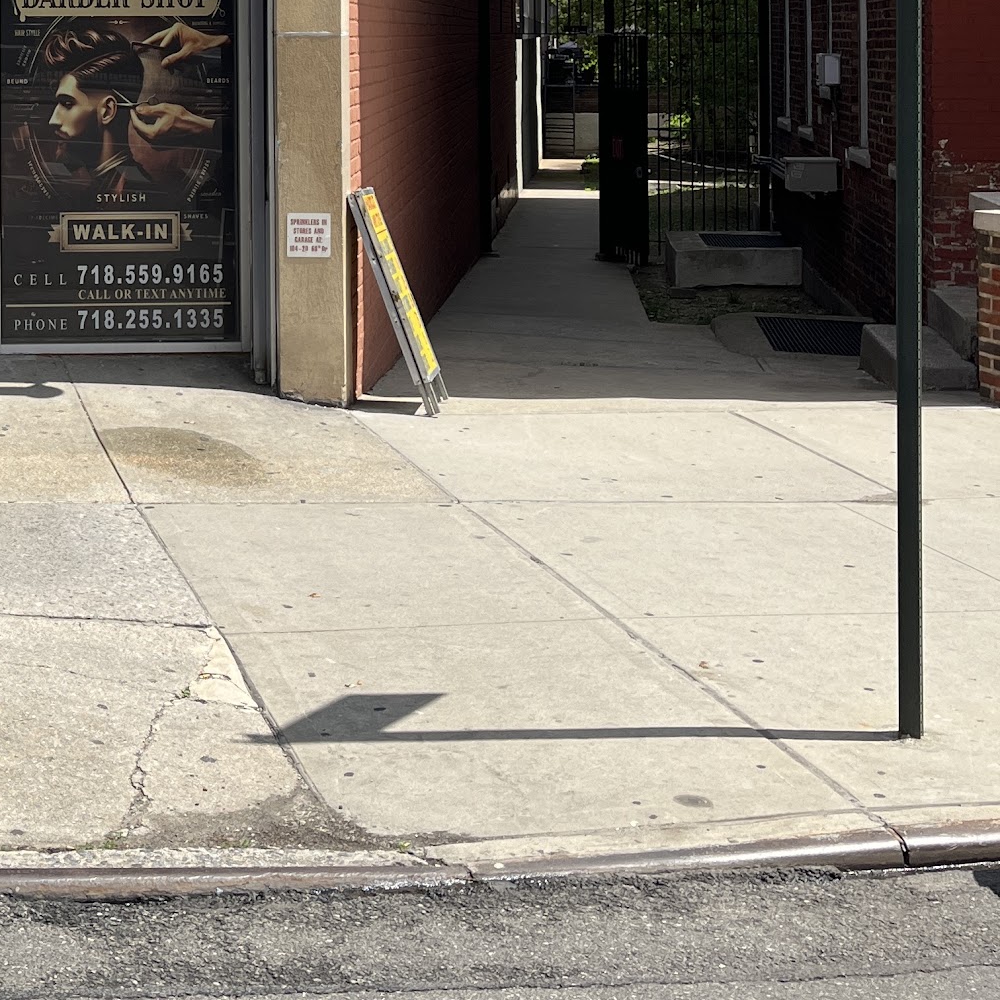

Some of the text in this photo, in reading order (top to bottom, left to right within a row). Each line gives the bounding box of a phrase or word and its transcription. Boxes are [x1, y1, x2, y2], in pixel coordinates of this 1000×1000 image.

[96, 193, 147, 203] STYLISH
[73, 223, 169, 240] WALK-IN
[313, 227, 325, 235] AND
[14, 263, 224, 286] CELL 718.559.9165
[78, 288, 227, 300] CALL OR TEXT ANYTIME
[14, 309, 224, 331] PHONE 718.255.1335
